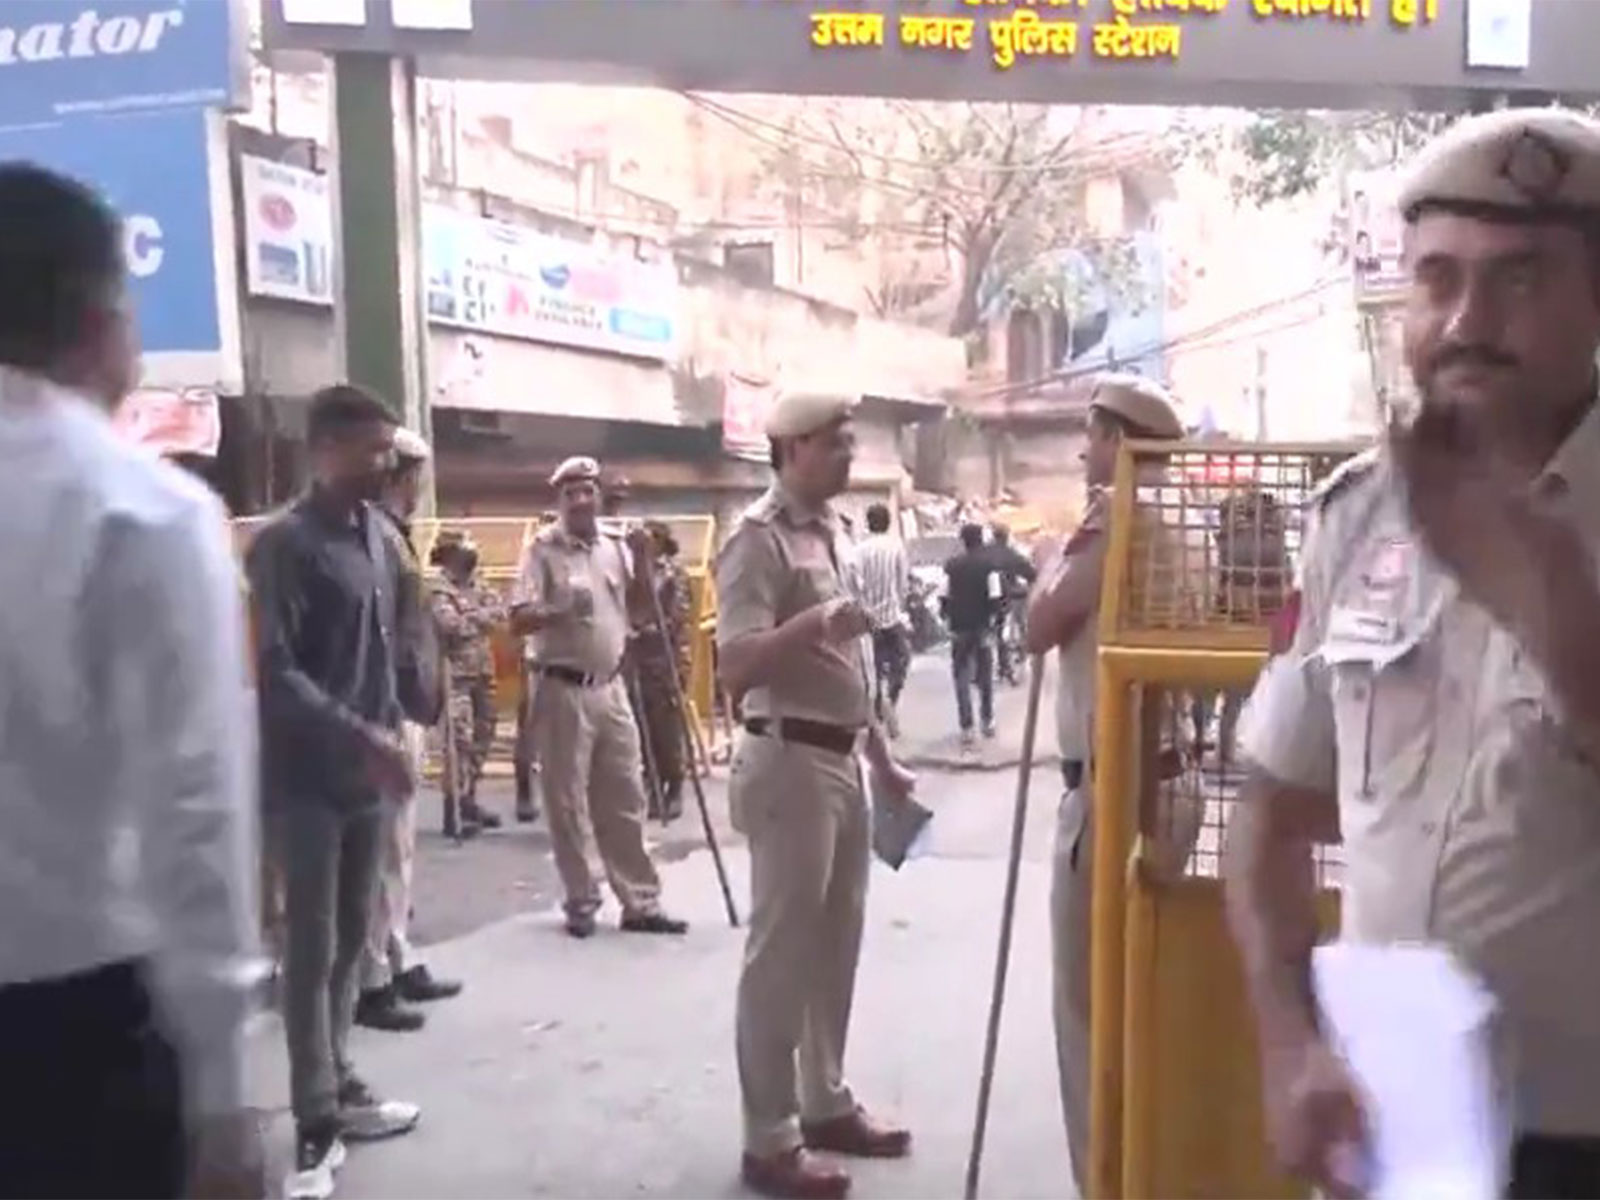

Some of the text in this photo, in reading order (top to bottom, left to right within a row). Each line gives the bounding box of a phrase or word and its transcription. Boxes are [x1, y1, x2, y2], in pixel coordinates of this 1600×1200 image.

[809, 13, 884, 46] उत्तम
[900, 16, 975, 50] नगर
[989, 8, 1077, 67] पुलिस
[1093, 14, 1181, 56] स्टेशन
